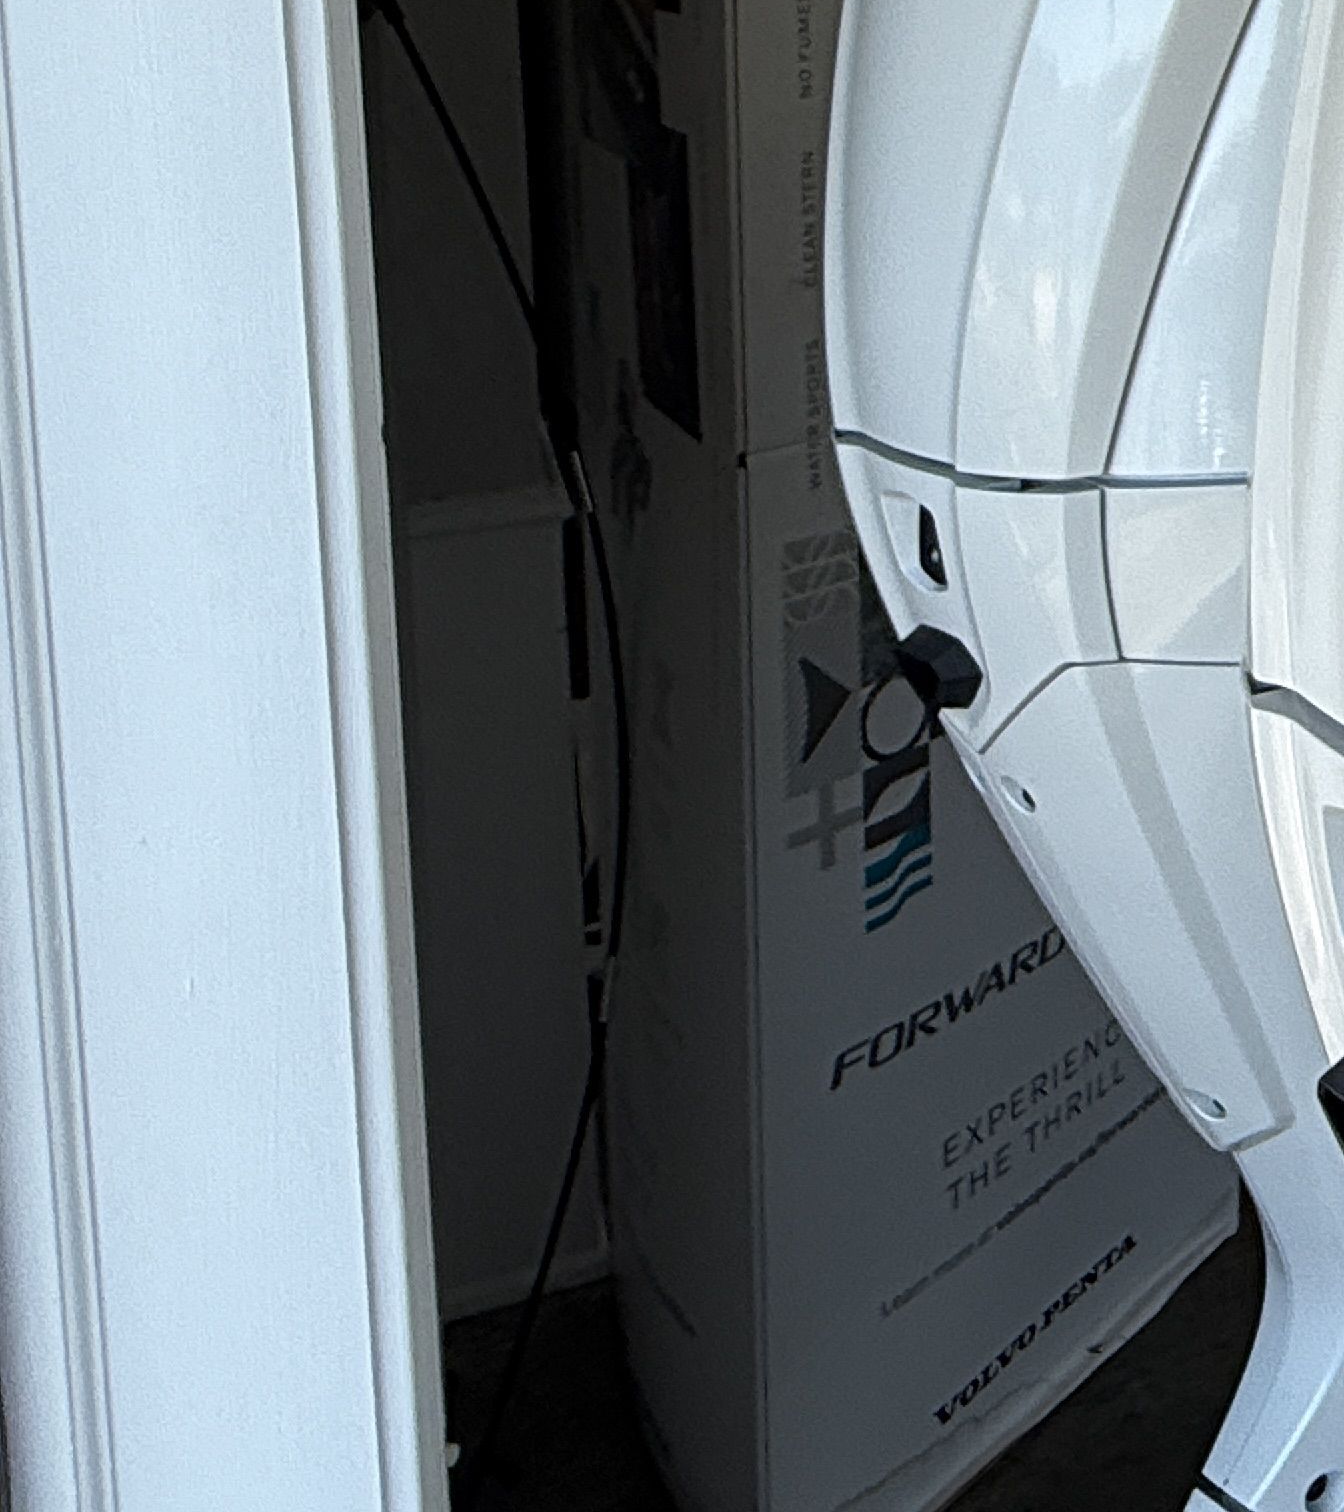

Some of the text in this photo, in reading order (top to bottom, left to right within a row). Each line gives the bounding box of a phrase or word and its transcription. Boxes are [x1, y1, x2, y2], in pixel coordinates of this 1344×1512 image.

[830, 925, 1066, 1091] FORWARD
[943, 1019, 1121, 1169] EXPERIENC
[945, 1060, 1125, 1209] THE THRILL
[934, 1234, 1137, 1425] VOLVO PENTA
